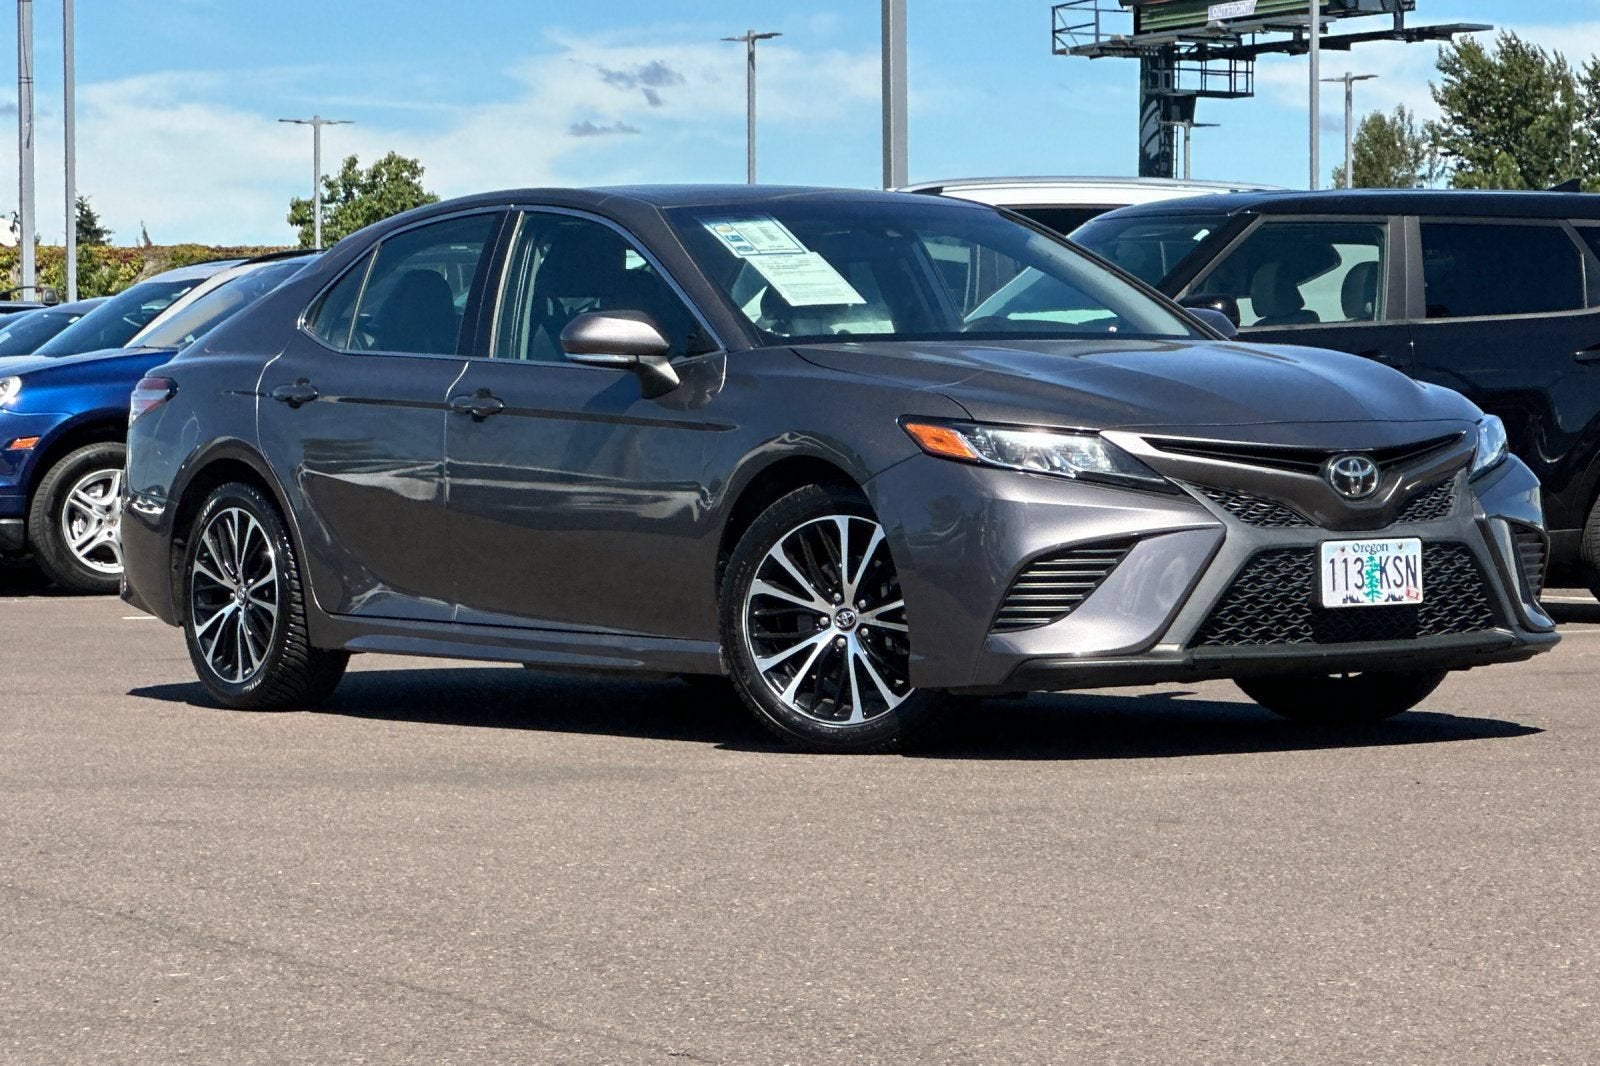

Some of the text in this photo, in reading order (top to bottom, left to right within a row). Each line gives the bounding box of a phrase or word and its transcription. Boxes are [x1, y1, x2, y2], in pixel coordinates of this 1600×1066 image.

[1212, 2, 1253, 18] OUTFRONT
[1352, 542, 1389, 555] Oregon
[1329, 554, 1418, 592] 113 KSN
